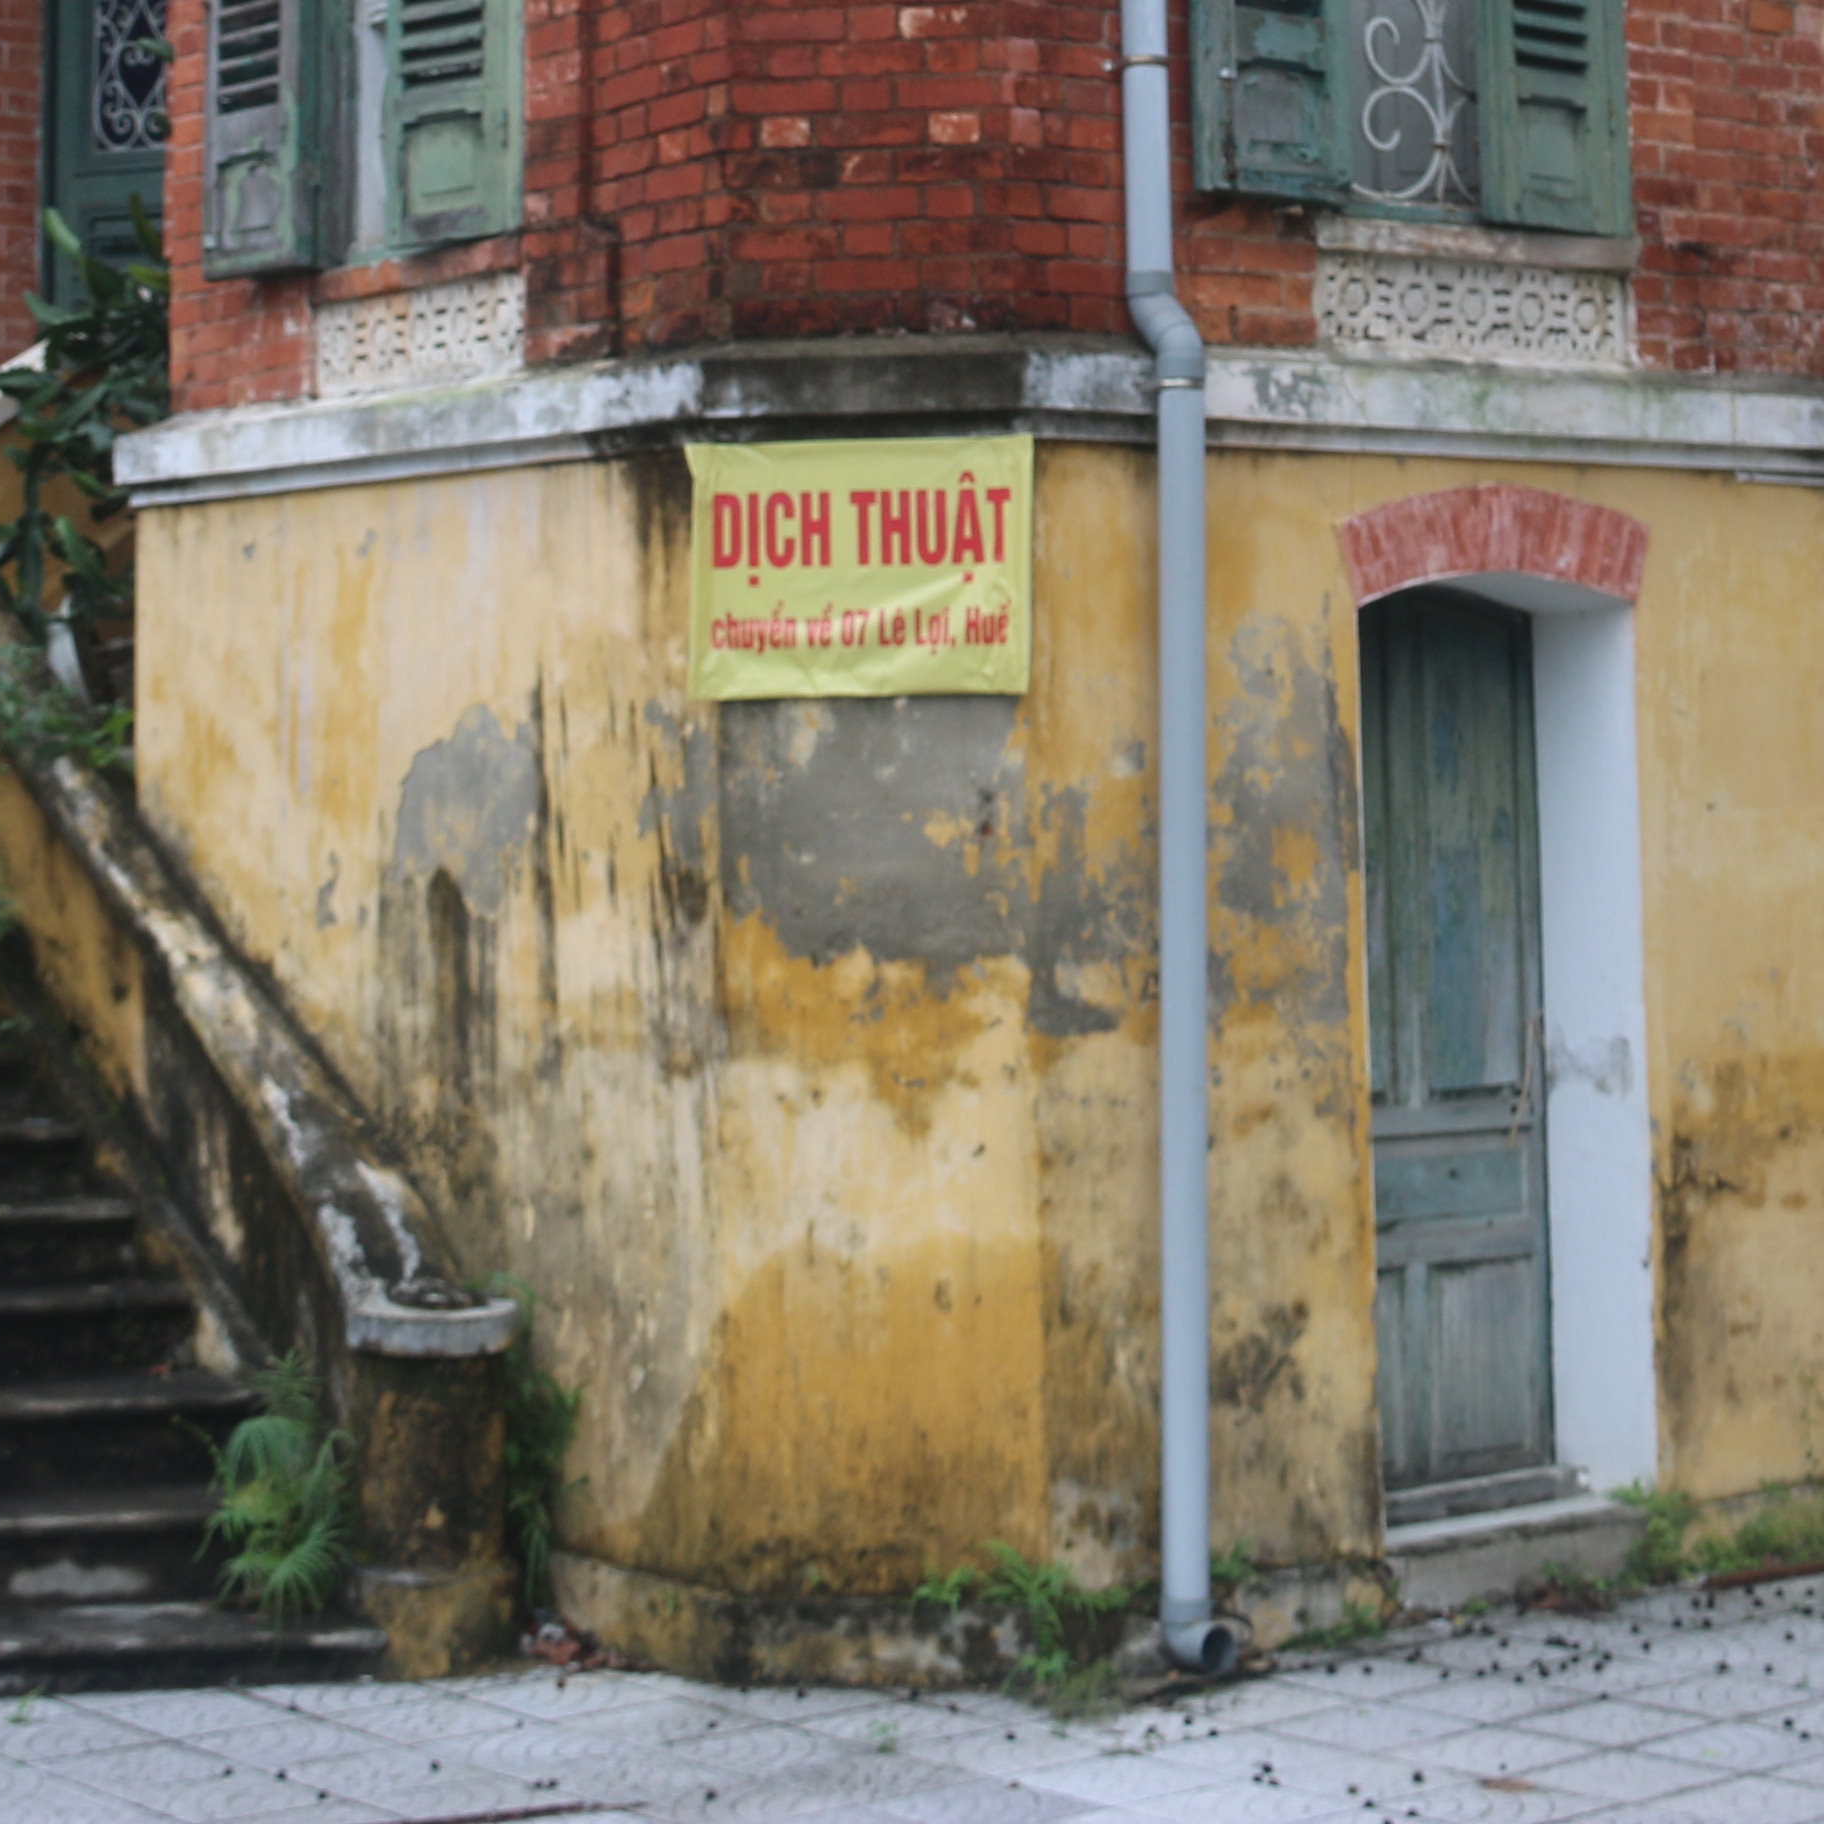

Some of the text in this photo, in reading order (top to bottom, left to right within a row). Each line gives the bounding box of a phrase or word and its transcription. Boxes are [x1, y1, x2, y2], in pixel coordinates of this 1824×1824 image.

[712, 470, 1012, 587] DỊCH THUẬT
[841, 607, 871, 649] 07
[878, 606, 906, 647] Lê
[964, 596, 1013, 646] Huế
